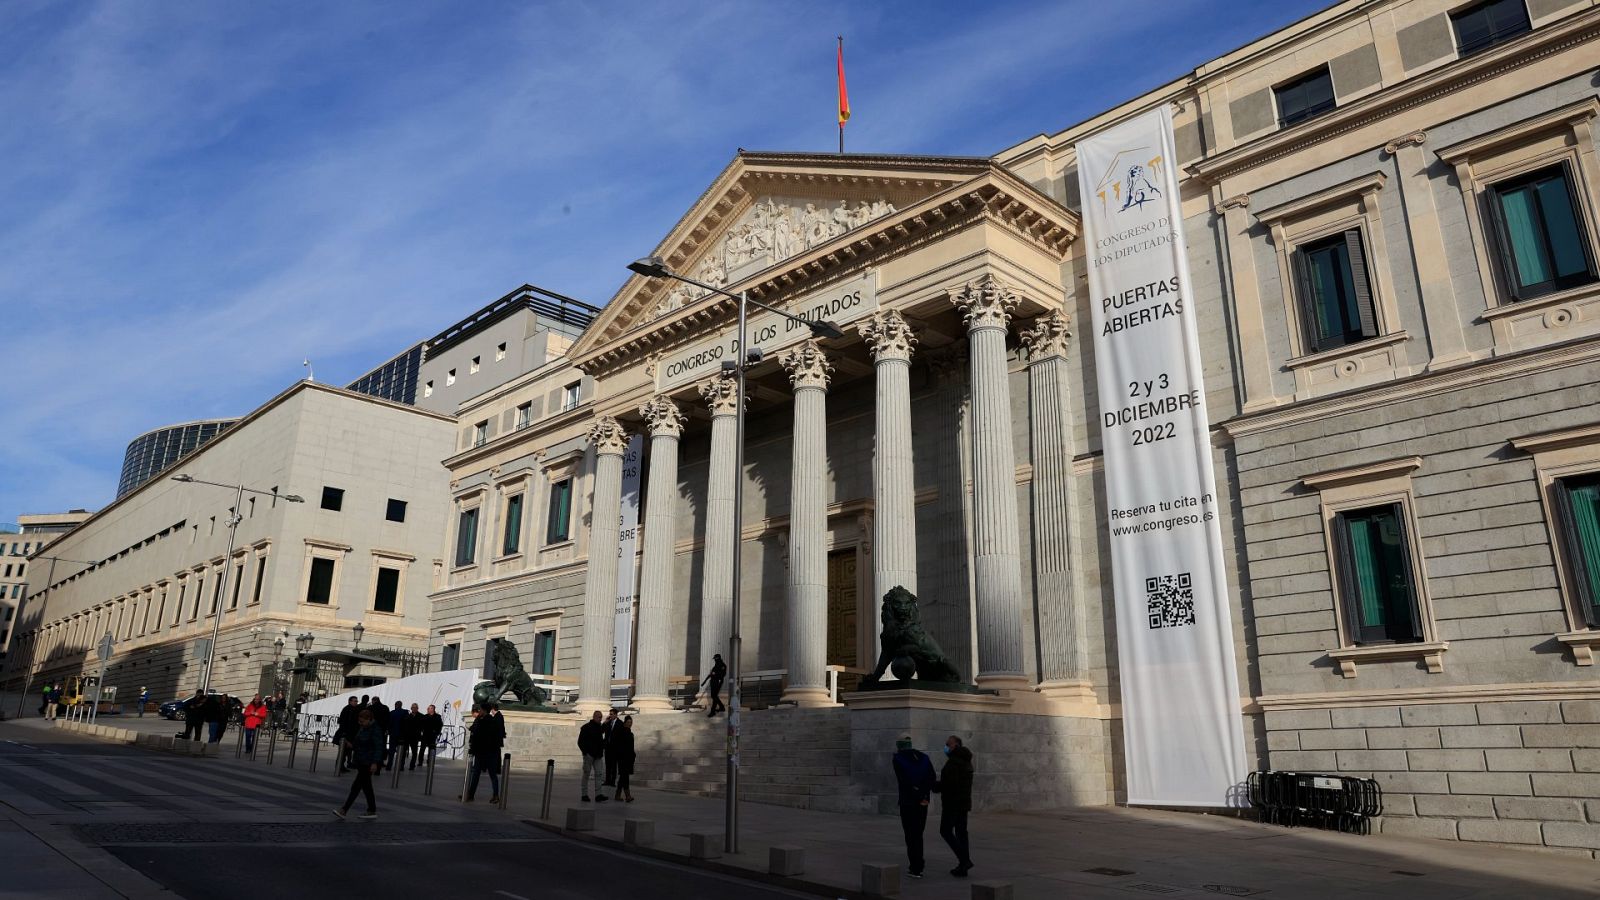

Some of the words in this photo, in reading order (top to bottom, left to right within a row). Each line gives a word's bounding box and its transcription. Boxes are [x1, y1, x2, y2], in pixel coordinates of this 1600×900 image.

[1094, 252, 1113, 268] LOS
[1115, 229, 1179, 260] DIPUTADOS
[1096, 221, 1156, 249] CONGRESO
[1102, 275, 1181, 314] PUERTAS
[666, 345, 724, 378] CONGRESO
[753, 324, 777, 345] LOS
[785, 290, 861, 333] DIPUTADOS
[1102, 299, 1184, 337] ABIERTAS
[1128, 381, 1140, 398] 2
[1144, 380, 1154, 398] y
[1158, 373, 1170, 390] 3
[1104, 389, 1201, 428] DICIEMBRE
[1132, 422, 1177, 446] 2022
[1111, 504, 1156, 520] Reserva
[1159, 501, 1171, 512] tu
[1174, 496, 1197, 509] cita
[1201, 493, 1212, 504] en
[1113, 511, 1214, 536] www.congreso.es
